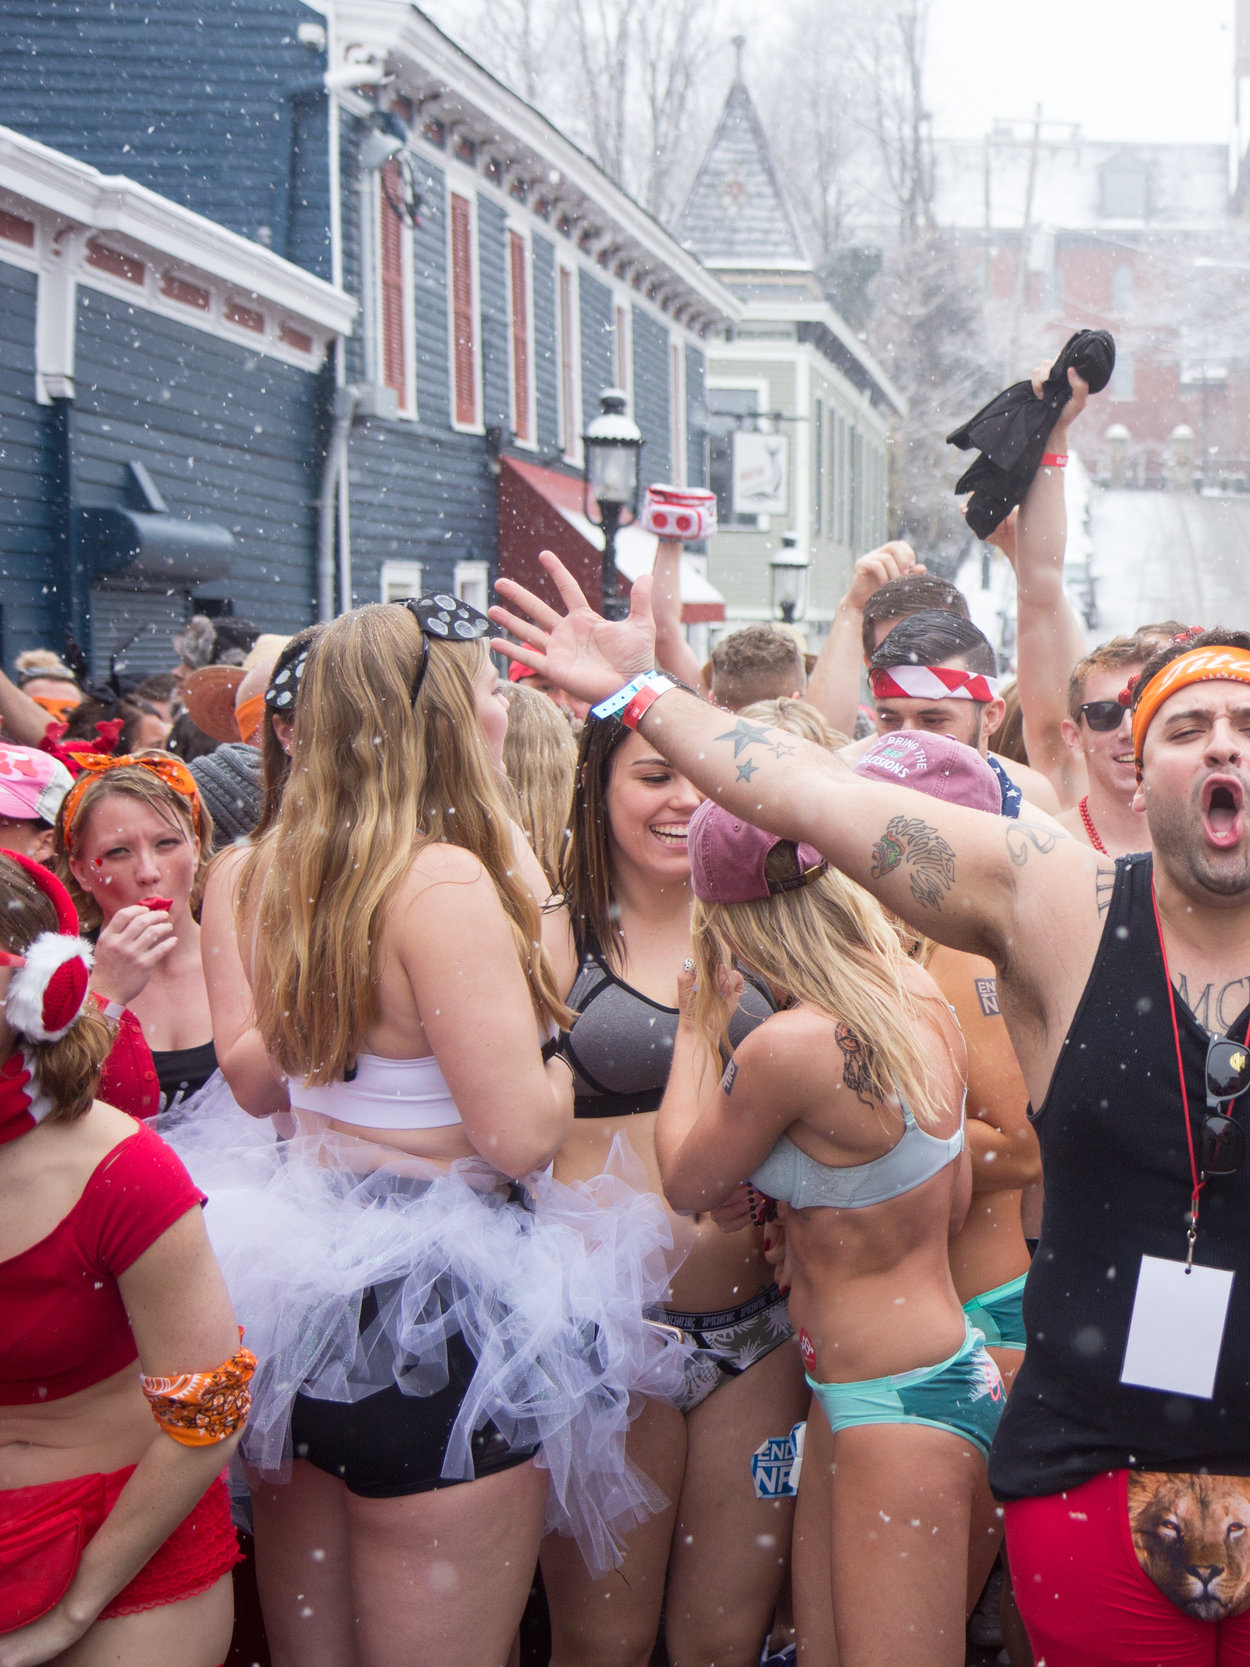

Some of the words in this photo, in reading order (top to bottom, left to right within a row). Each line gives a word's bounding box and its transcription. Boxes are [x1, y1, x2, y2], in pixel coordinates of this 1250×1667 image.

[882, 747, 903, 758] BAD
[887, 736, 919, 750] BRING
[914, 748, 927, 769] THE
[977, 981, 996, 993] EN
[982, 996, 1000, 1014] N
